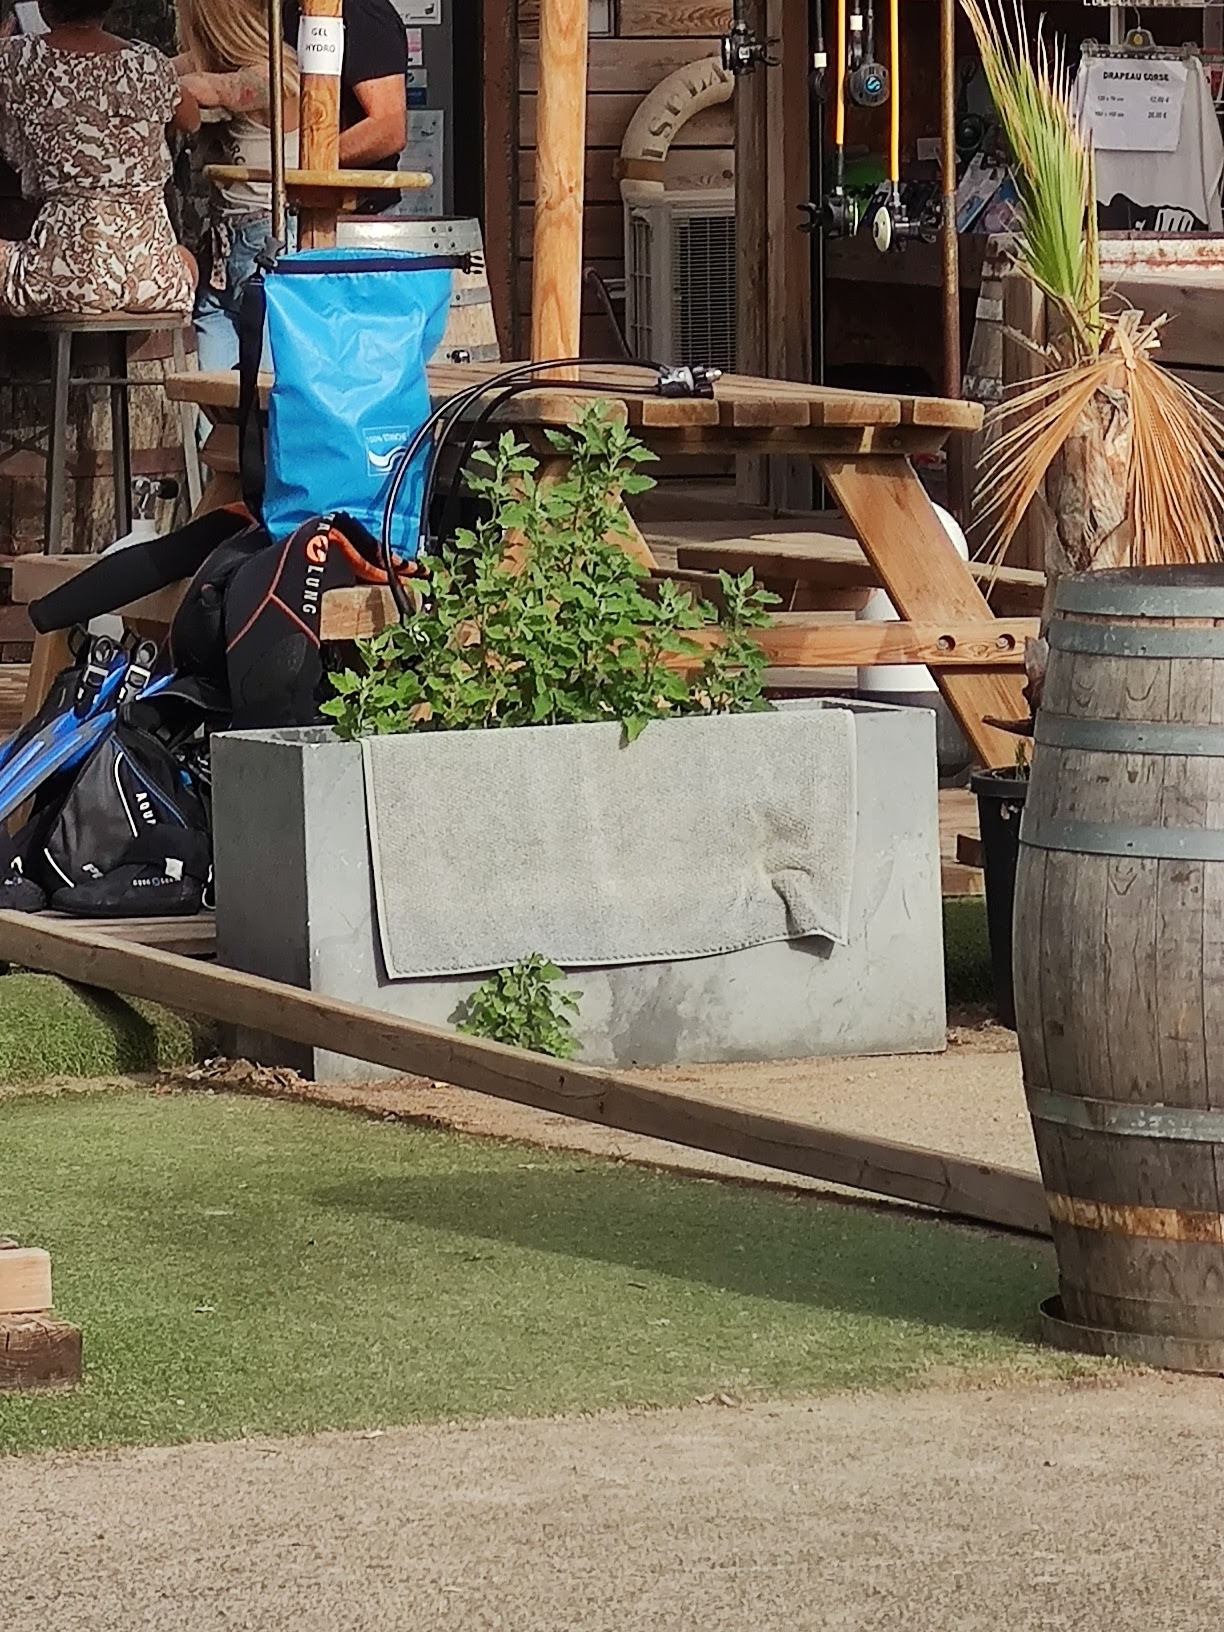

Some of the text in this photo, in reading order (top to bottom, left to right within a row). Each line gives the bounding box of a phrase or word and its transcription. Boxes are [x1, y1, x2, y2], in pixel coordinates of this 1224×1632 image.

[311, 27, 328, 37] GEL
[305, 43, 336, 54] HYDRO
[1103, 71, 1169, 82] DRAPEAU CORSE
[302, 565, 325, 615] LUNG
